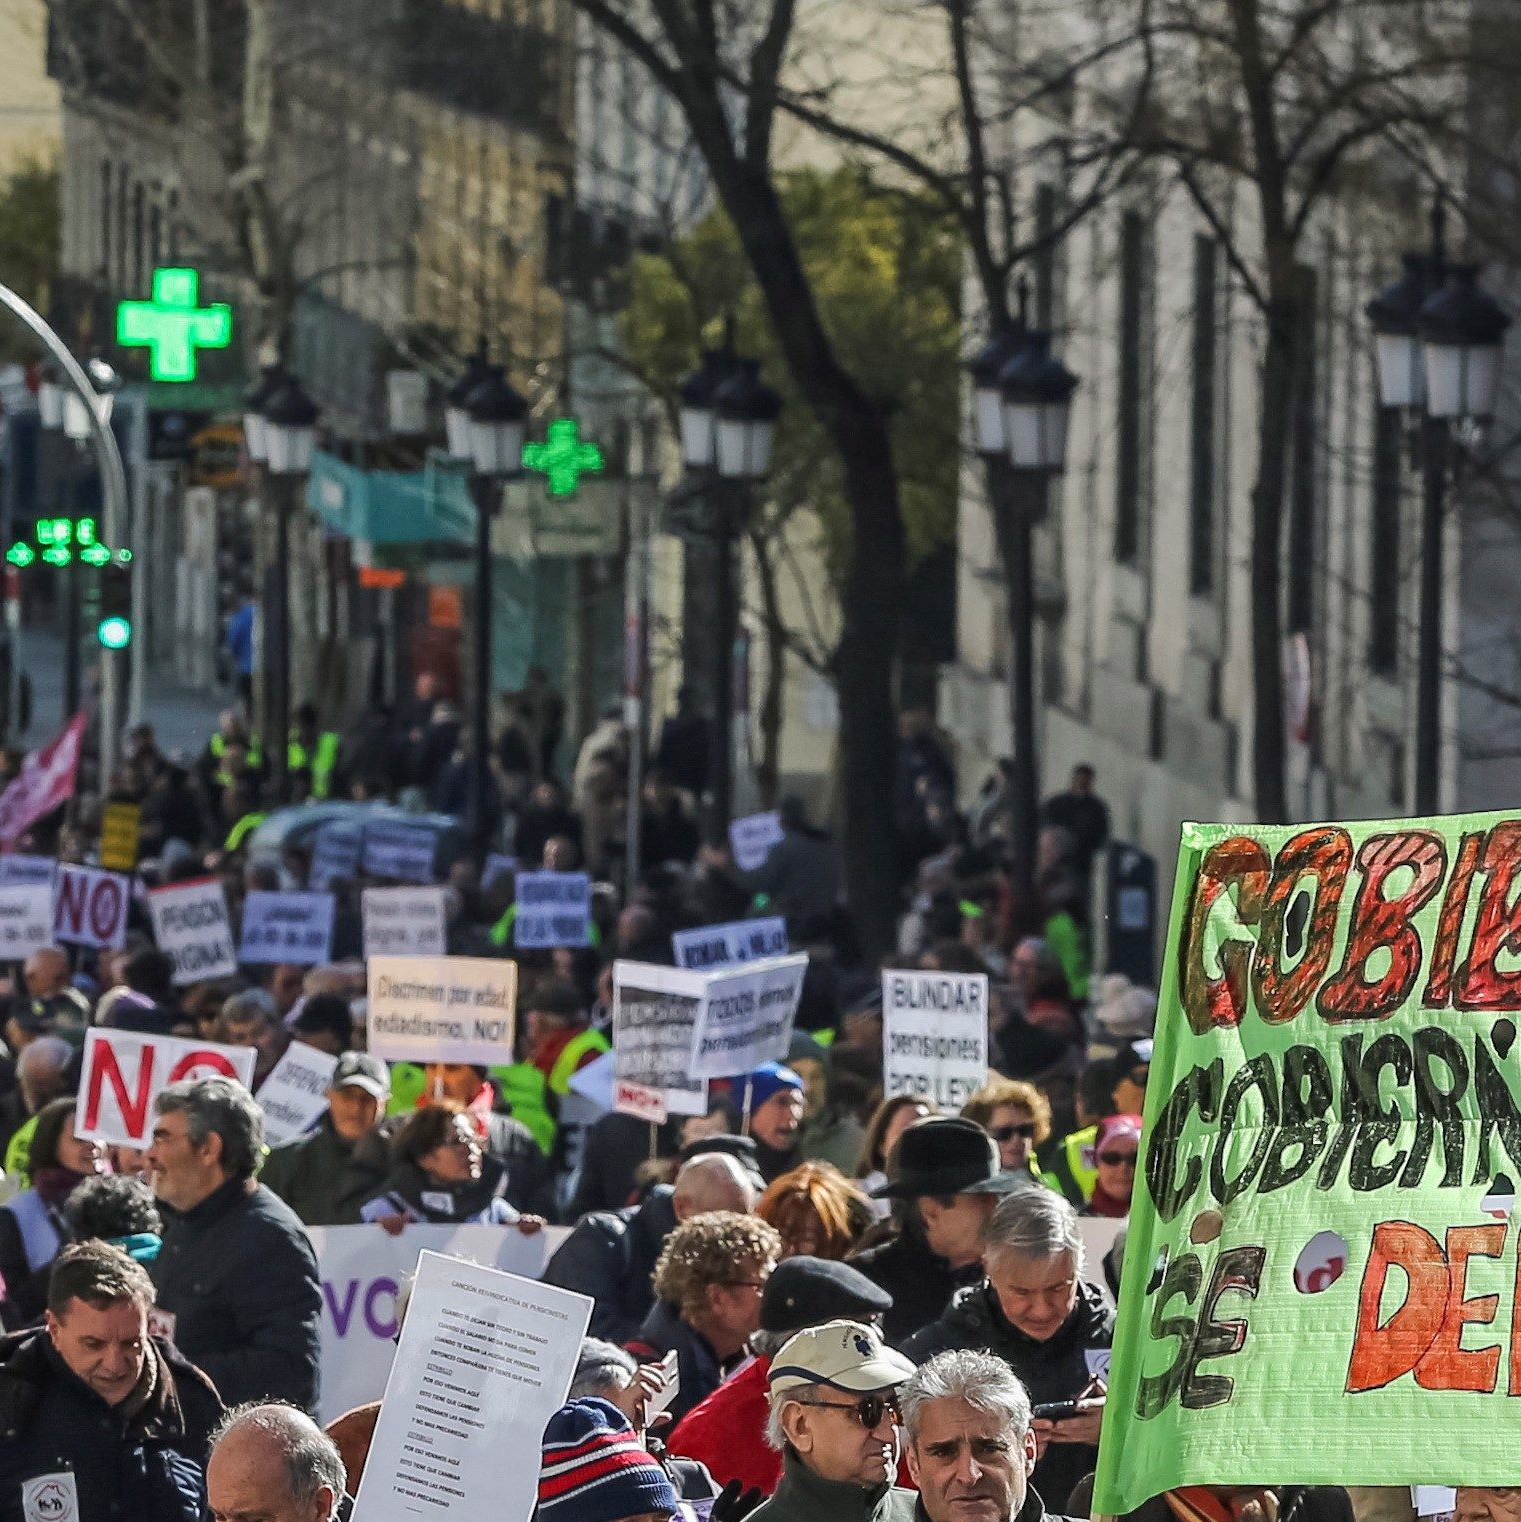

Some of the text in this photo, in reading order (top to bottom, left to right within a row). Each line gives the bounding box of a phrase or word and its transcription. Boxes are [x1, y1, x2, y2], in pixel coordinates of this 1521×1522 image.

[55, 872, 123, 940] NO
[891, 979, 980, 1012] BLINDAR
[890, 1033, 980, 1061] pensiones
[1134, 1245, 1266, 1420] SE
